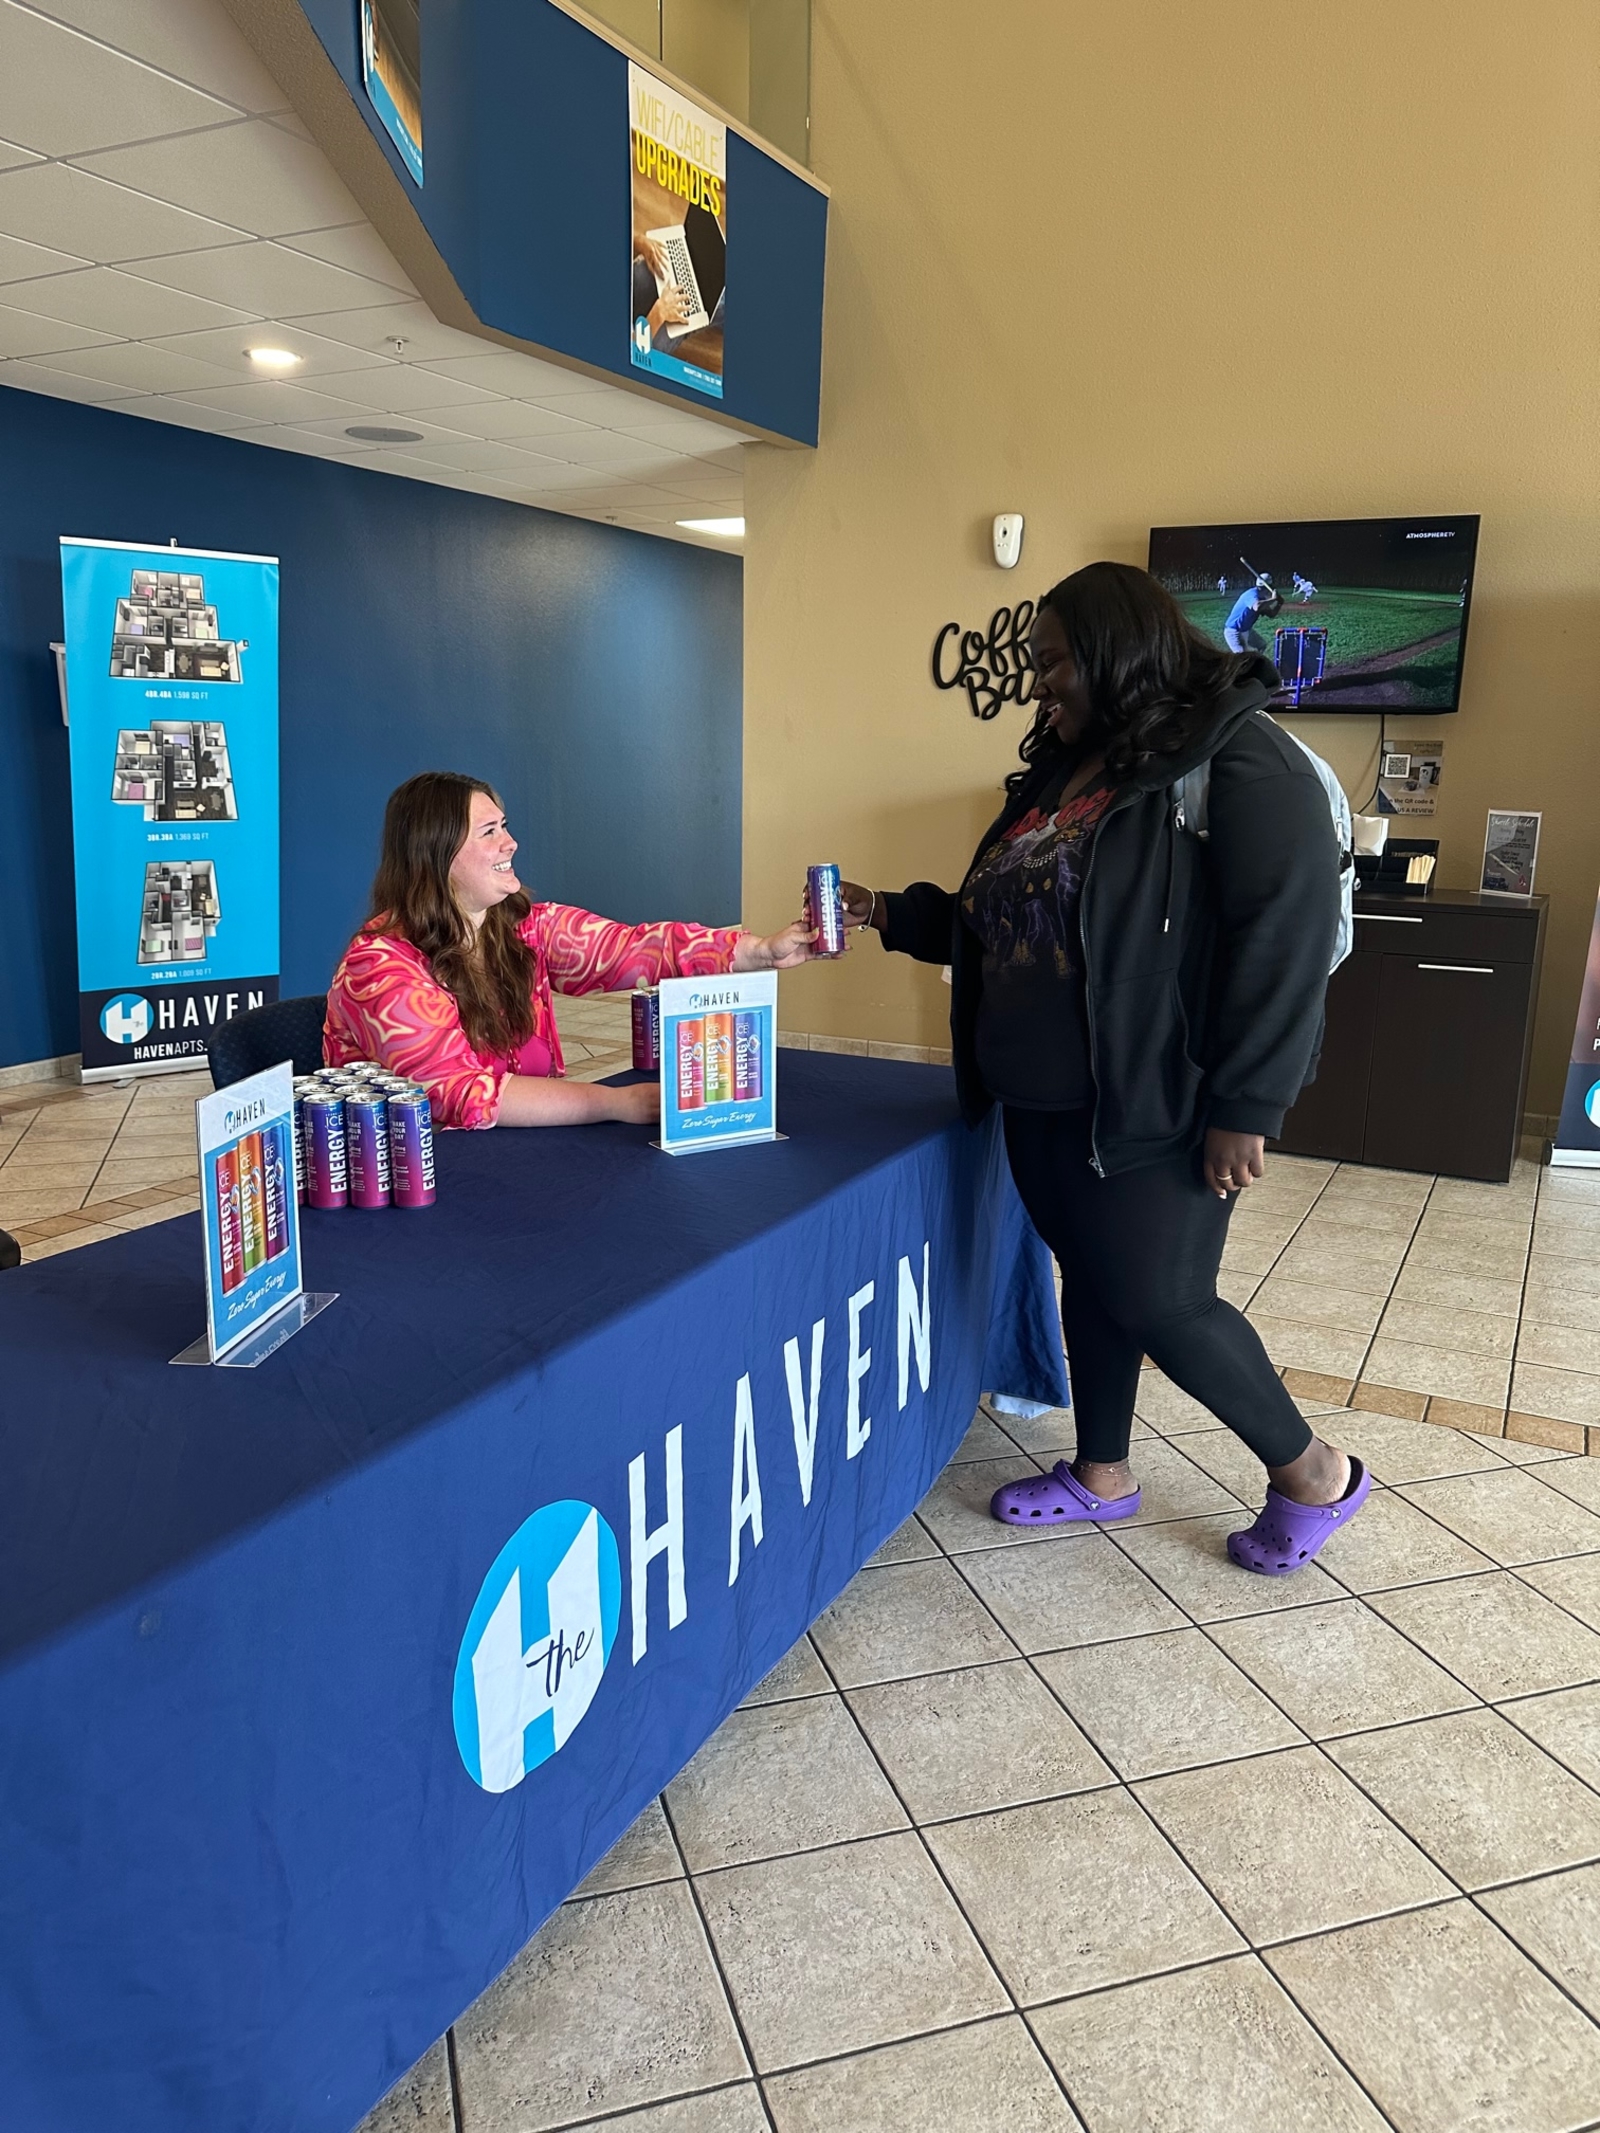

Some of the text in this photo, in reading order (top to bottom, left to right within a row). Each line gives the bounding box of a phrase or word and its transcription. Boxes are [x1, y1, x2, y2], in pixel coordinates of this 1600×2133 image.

[637, 86, 718, 173] WIFI/CABLE
[635, 129, 721, 217] UPGRADES
[932, 600, 1036, 690] Coff
[191, 692, 200, 700] SQ
[200, 692, 209, 700] FT
[959, 666, 1038, 721] Ba
[192, 832, 200, 840] SQ
[201, 832, 209, 840] FT
[204, 967, 212, 975] FT
[158, 991, 263, 1030] HAVEN
[703, 991, 740, 1007] HAVEN
[133, 1039, 208, 1060] HAVENAPTS.
[680, 1043, 692, 1098] ENERGY
[706, 1037, 718, 1090] ENERGY
[736, 1036, 748, 1089] ENERGY
[236, 1098, 266, 1127] HAVEN
[681, 1111, 758, 1129] Zero Sugar Energy
[327, 1129, 347, 1193] ENERGY
[375, 1128, 391, 1193] ENERGY
[419, 1127, 436, 1191] ENERGY
[240, 1171, 254, 1254] ENERGY
[264, 1163, 278, 1242] ENERGY
[219, 1190, 234, 1275] ENERGY
[227, 1270, 287, 1321] Zero Sugar Energy
[628, 1241, 931, 1667] HAVEN
[526, 1626, 595, 1698] the
